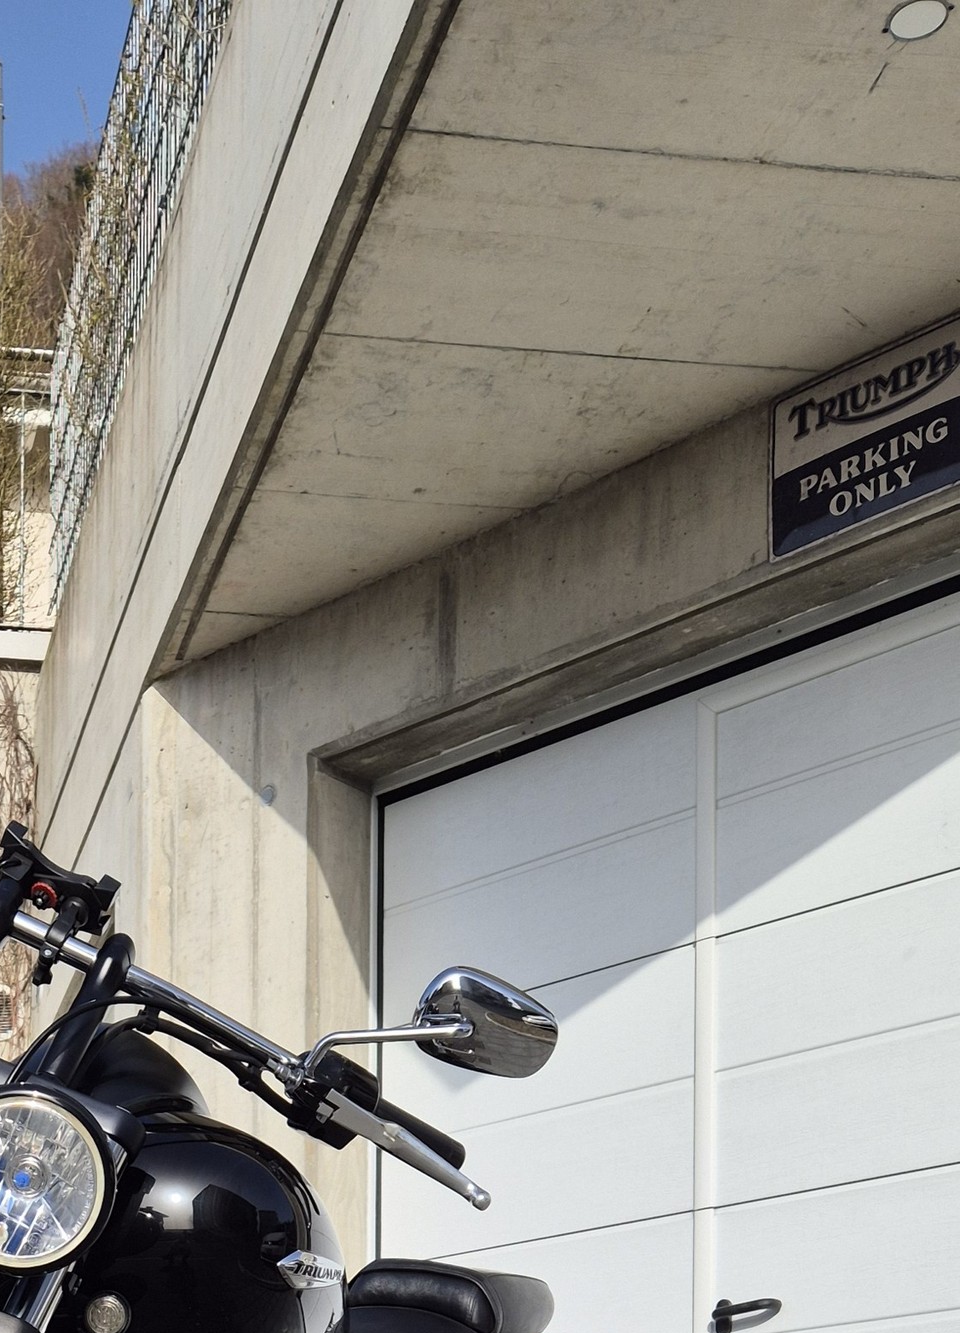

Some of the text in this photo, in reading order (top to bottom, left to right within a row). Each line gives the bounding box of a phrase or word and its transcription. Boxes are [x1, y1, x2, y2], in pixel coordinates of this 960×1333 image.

[788, 341, 959, 441] TRIUMPH
[799, 417, 948, 502] PARKING
[829, 461, 916, 517] ONLY
